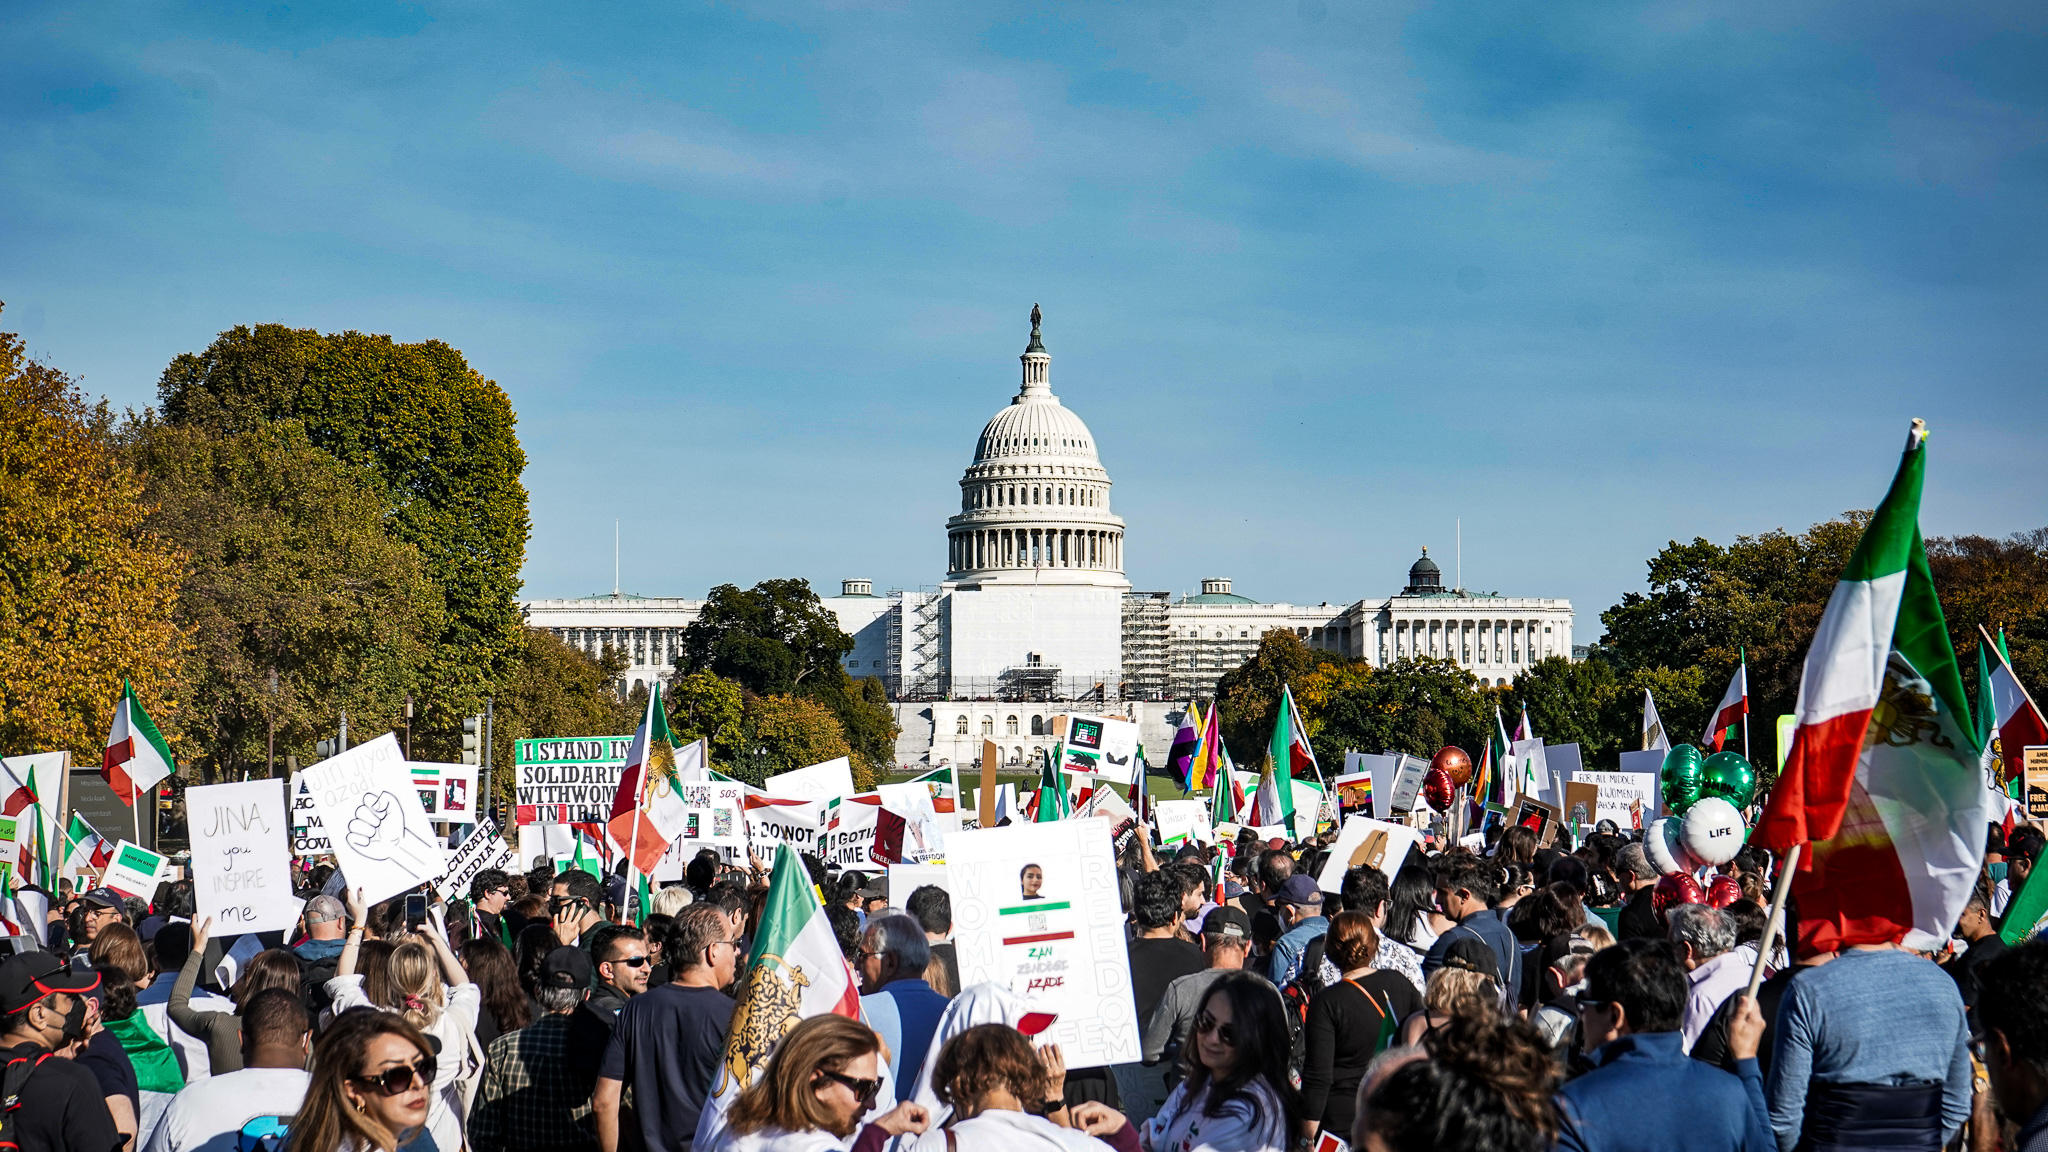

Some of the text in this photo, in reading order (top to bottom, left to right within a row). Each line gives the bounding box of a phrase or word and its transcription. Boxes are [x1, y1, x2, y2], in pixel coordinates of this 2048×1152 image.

[524, 741, 631, 761] I STAND IN
[313, 762, 344, 791] jin
[524, 766, 622, 784] SOLIDARI
[1579, 774, 1635, 785] FOR ALL MIDDLE
[324, 772, 375, 807] azadi
[720, 789, 737, 799] SOS
[1605, 788, 1632, 799] WOMEN
[1634, 790, 1645, 800] ALL
[2029, 794, 2046, 802] FREE
[536, 805, 558, 822] IN
[1162, 807, 1173, 815] UN
[204, 803, 270, 838] JINA,
[1709, 827, 1731, 838] LIFE
[223, 846, 252, 871] you
[450, 844, 496, 892] MEDIA
[126, 876, 147, 887] SOLIDARITY
[213, 868, 266, 894] INSPIRE
[221, 906, 257, 922] me
[950, 861, 994, 985] WOMA
[1076, 820, 1138, 1061] FREEDOM
[1028, 946, 1052, 959] ZAN
[1017, 960, 1069, 975] ZENDEGI
[1027, 976, 1064, 993] AZADI
